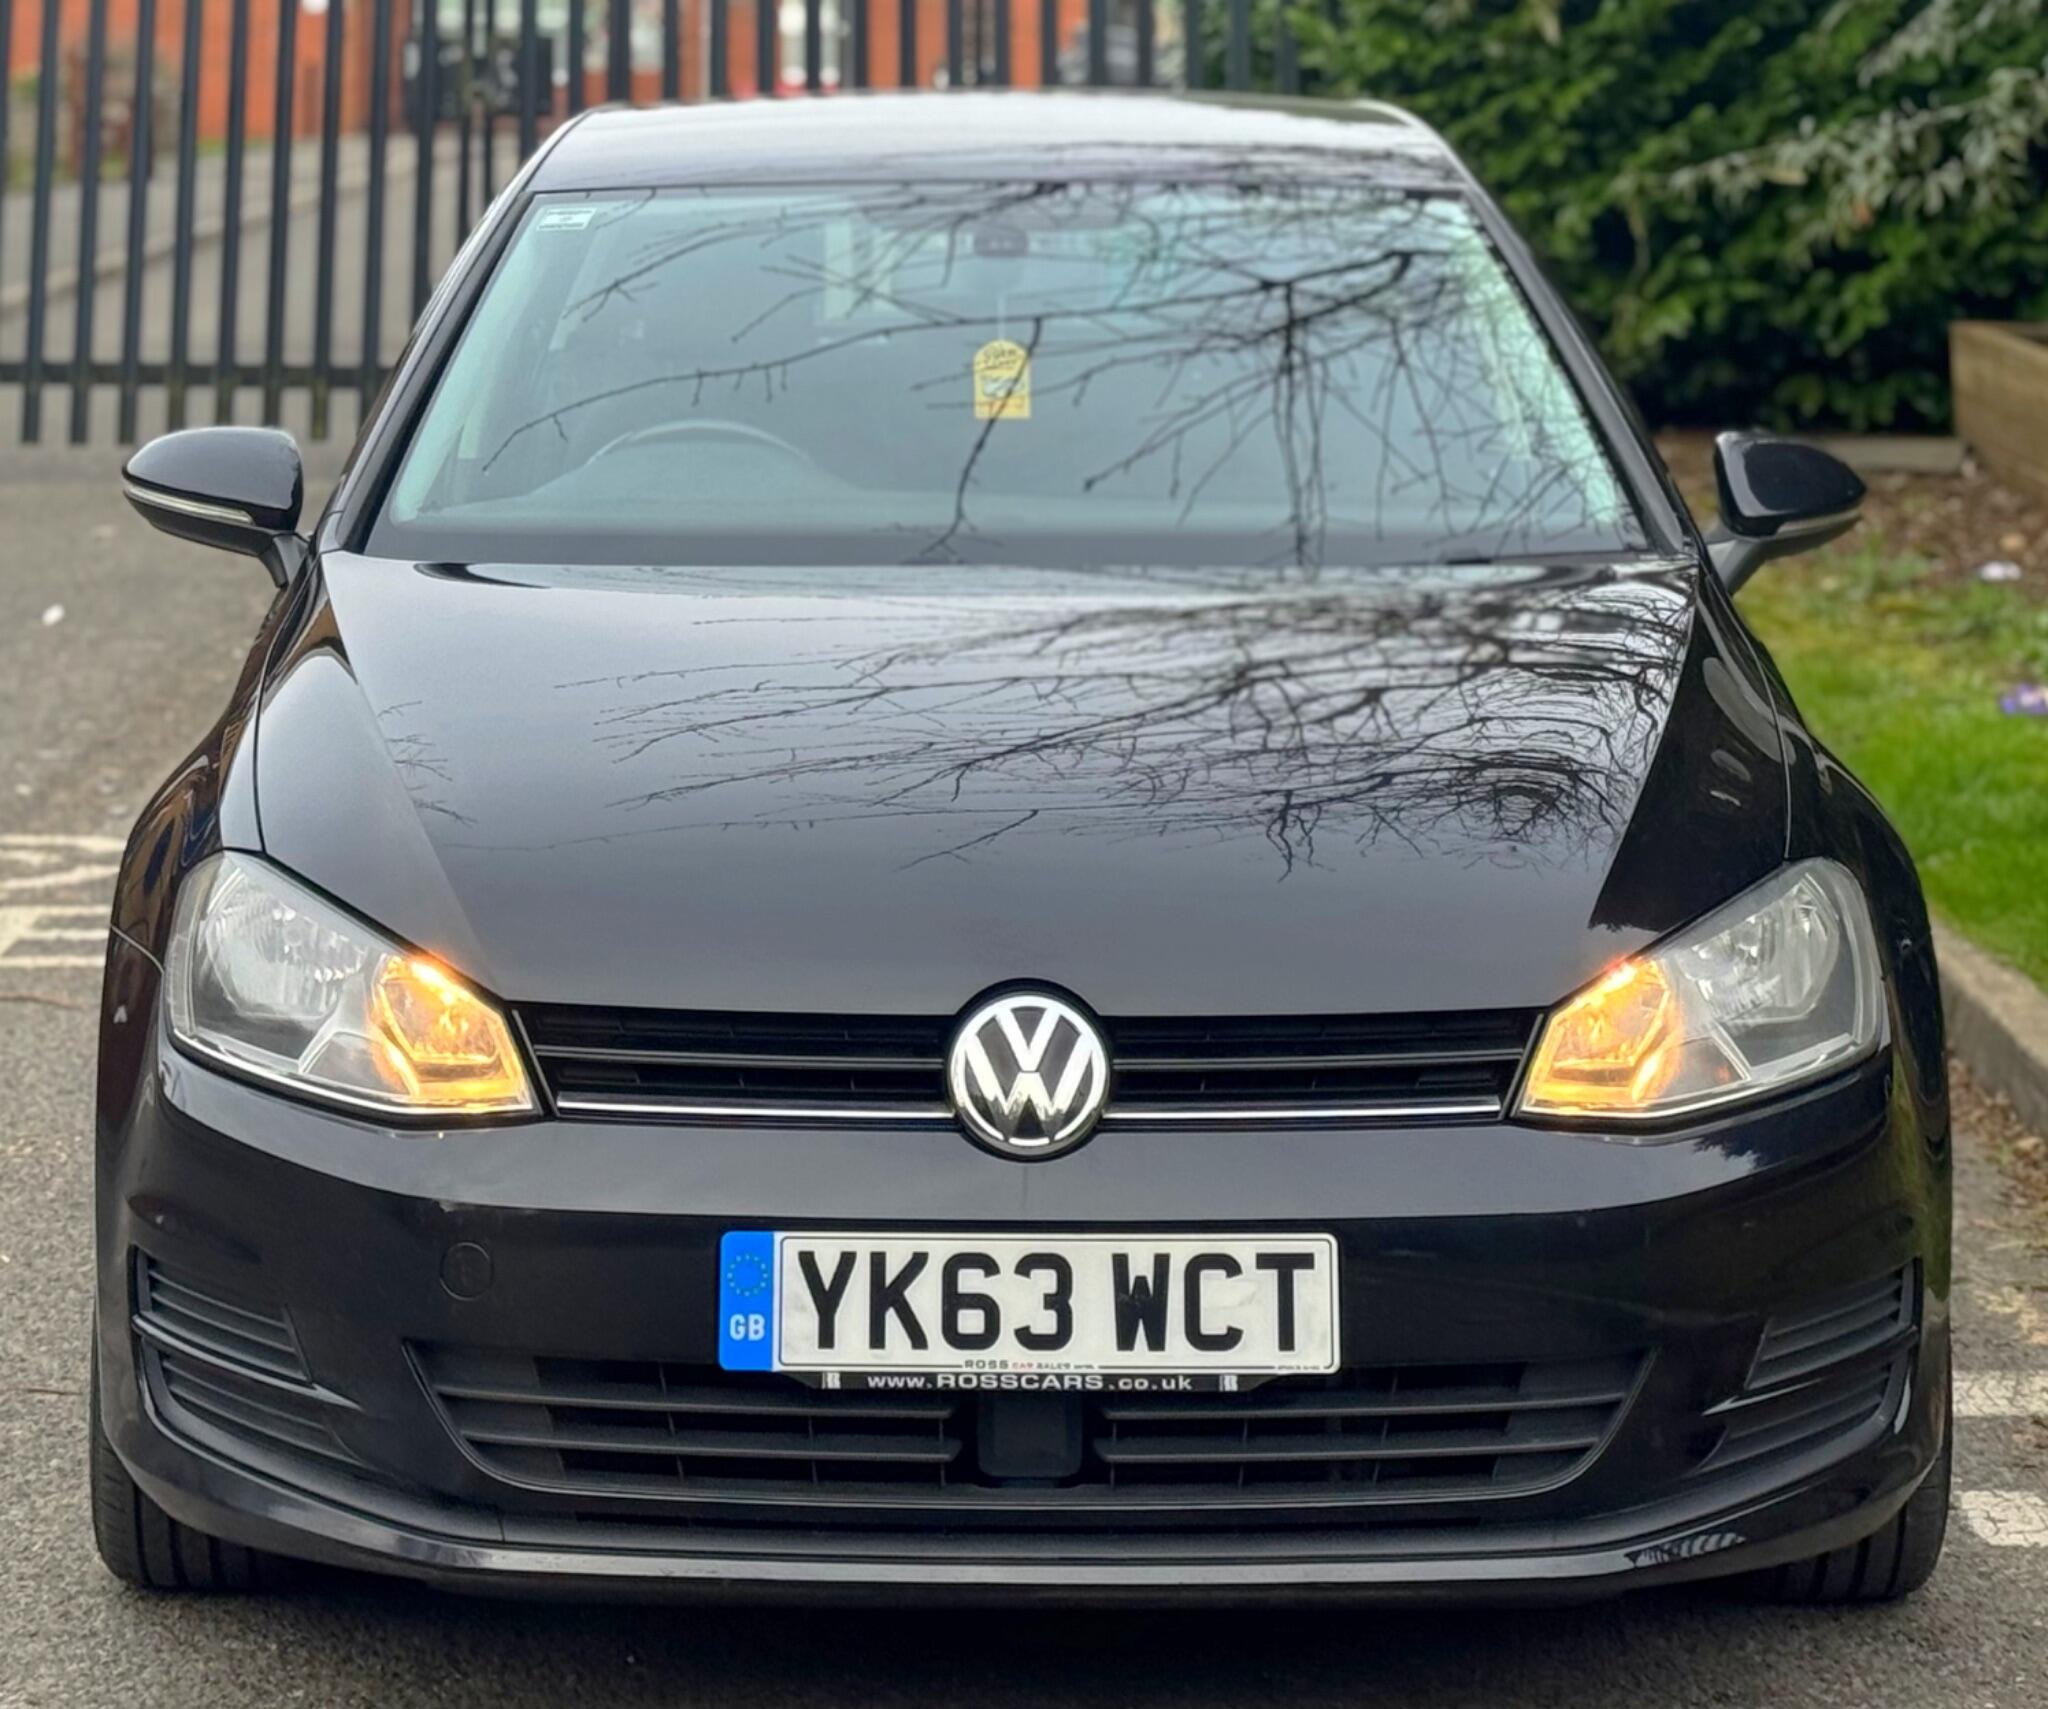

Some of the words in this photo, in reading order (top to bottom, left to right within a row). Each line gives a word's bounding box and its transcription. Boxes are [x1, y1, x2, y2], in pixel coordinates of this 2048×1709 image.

[798, 1250, 1073, 1351] YK63
[1112, 1252, 1315, 1352] WCT
[729, 1313, 766, 1341] GB
[964, 1359, 1009, 1370] ROSS
[866, 1373, 1193, 1391] www.ROSSCARS.co.uk
